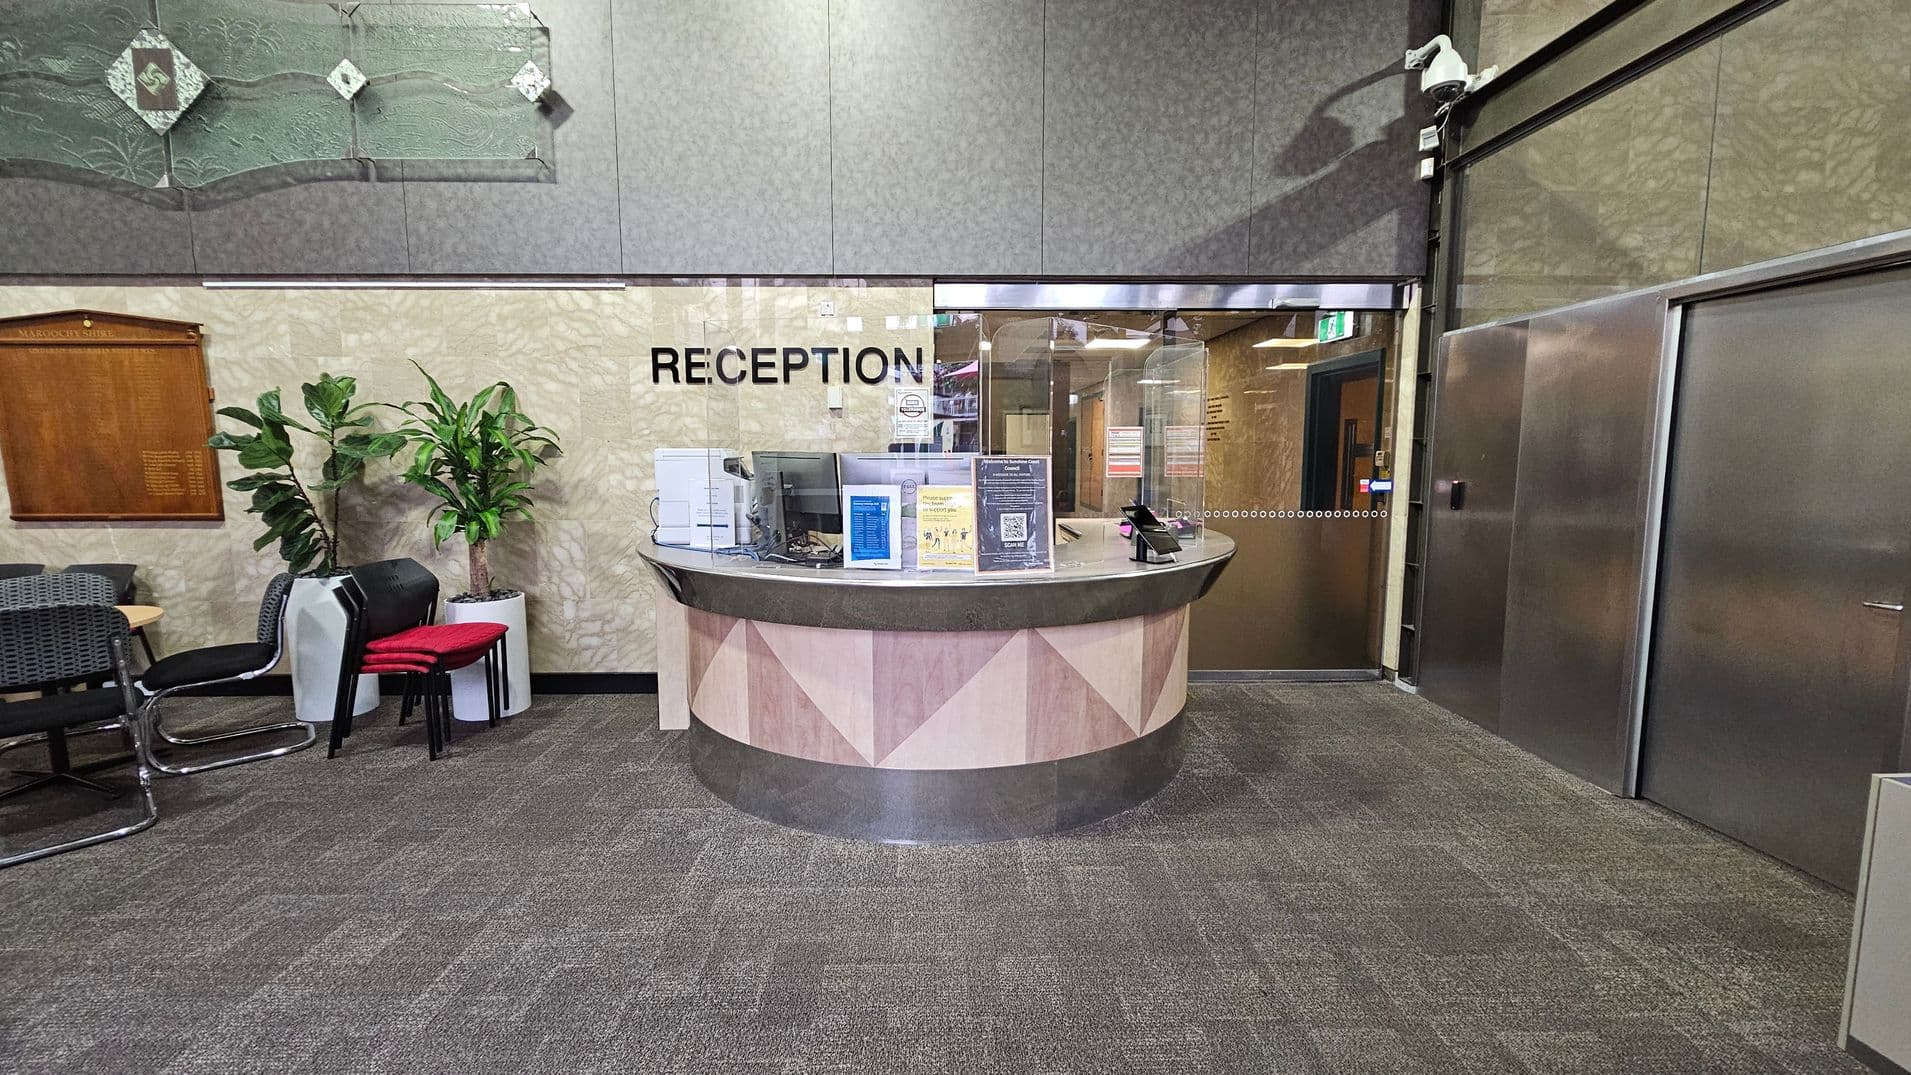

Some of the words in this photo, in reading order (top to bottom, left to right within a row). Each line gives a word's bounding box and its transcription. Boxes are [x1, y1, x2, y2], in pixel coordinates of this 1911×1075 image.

[19, 329, 80, 338] MAROOCHY
[82, 329, 114, 338] SHIRE
[651, 347, 924, 385] RECEPTION
